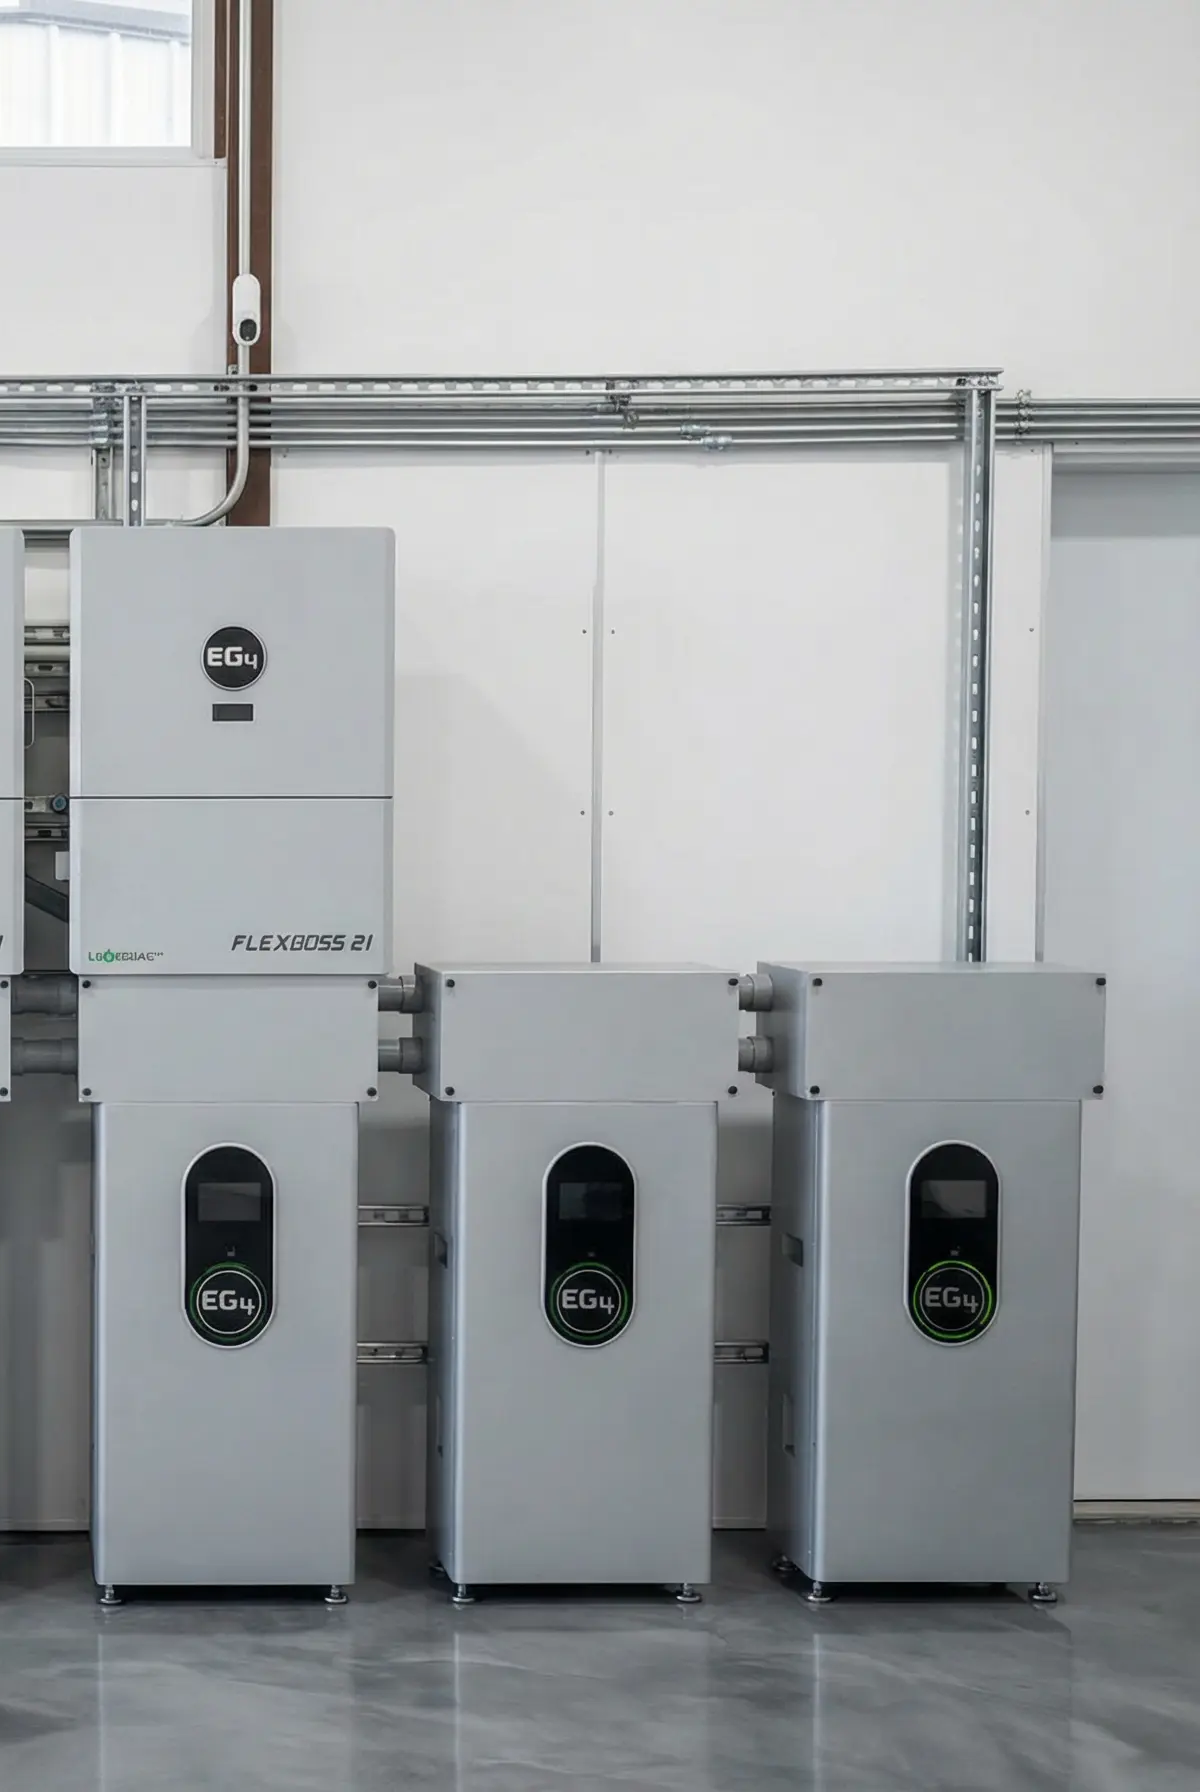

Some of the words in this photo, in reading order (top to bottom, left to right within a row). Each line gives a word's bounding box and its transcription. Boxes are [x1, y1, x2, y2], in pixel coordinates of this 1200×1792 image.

[207, 646, 258, 670] EG4
[231, 934, 346, 951] FLEXBOSS
[350, 934, 373, 951] 21
[202, 1290, 255, 1316] EG4
[562, 1288, 614, 1314] EG4
[925, 1286, 979, 1313] EG4
